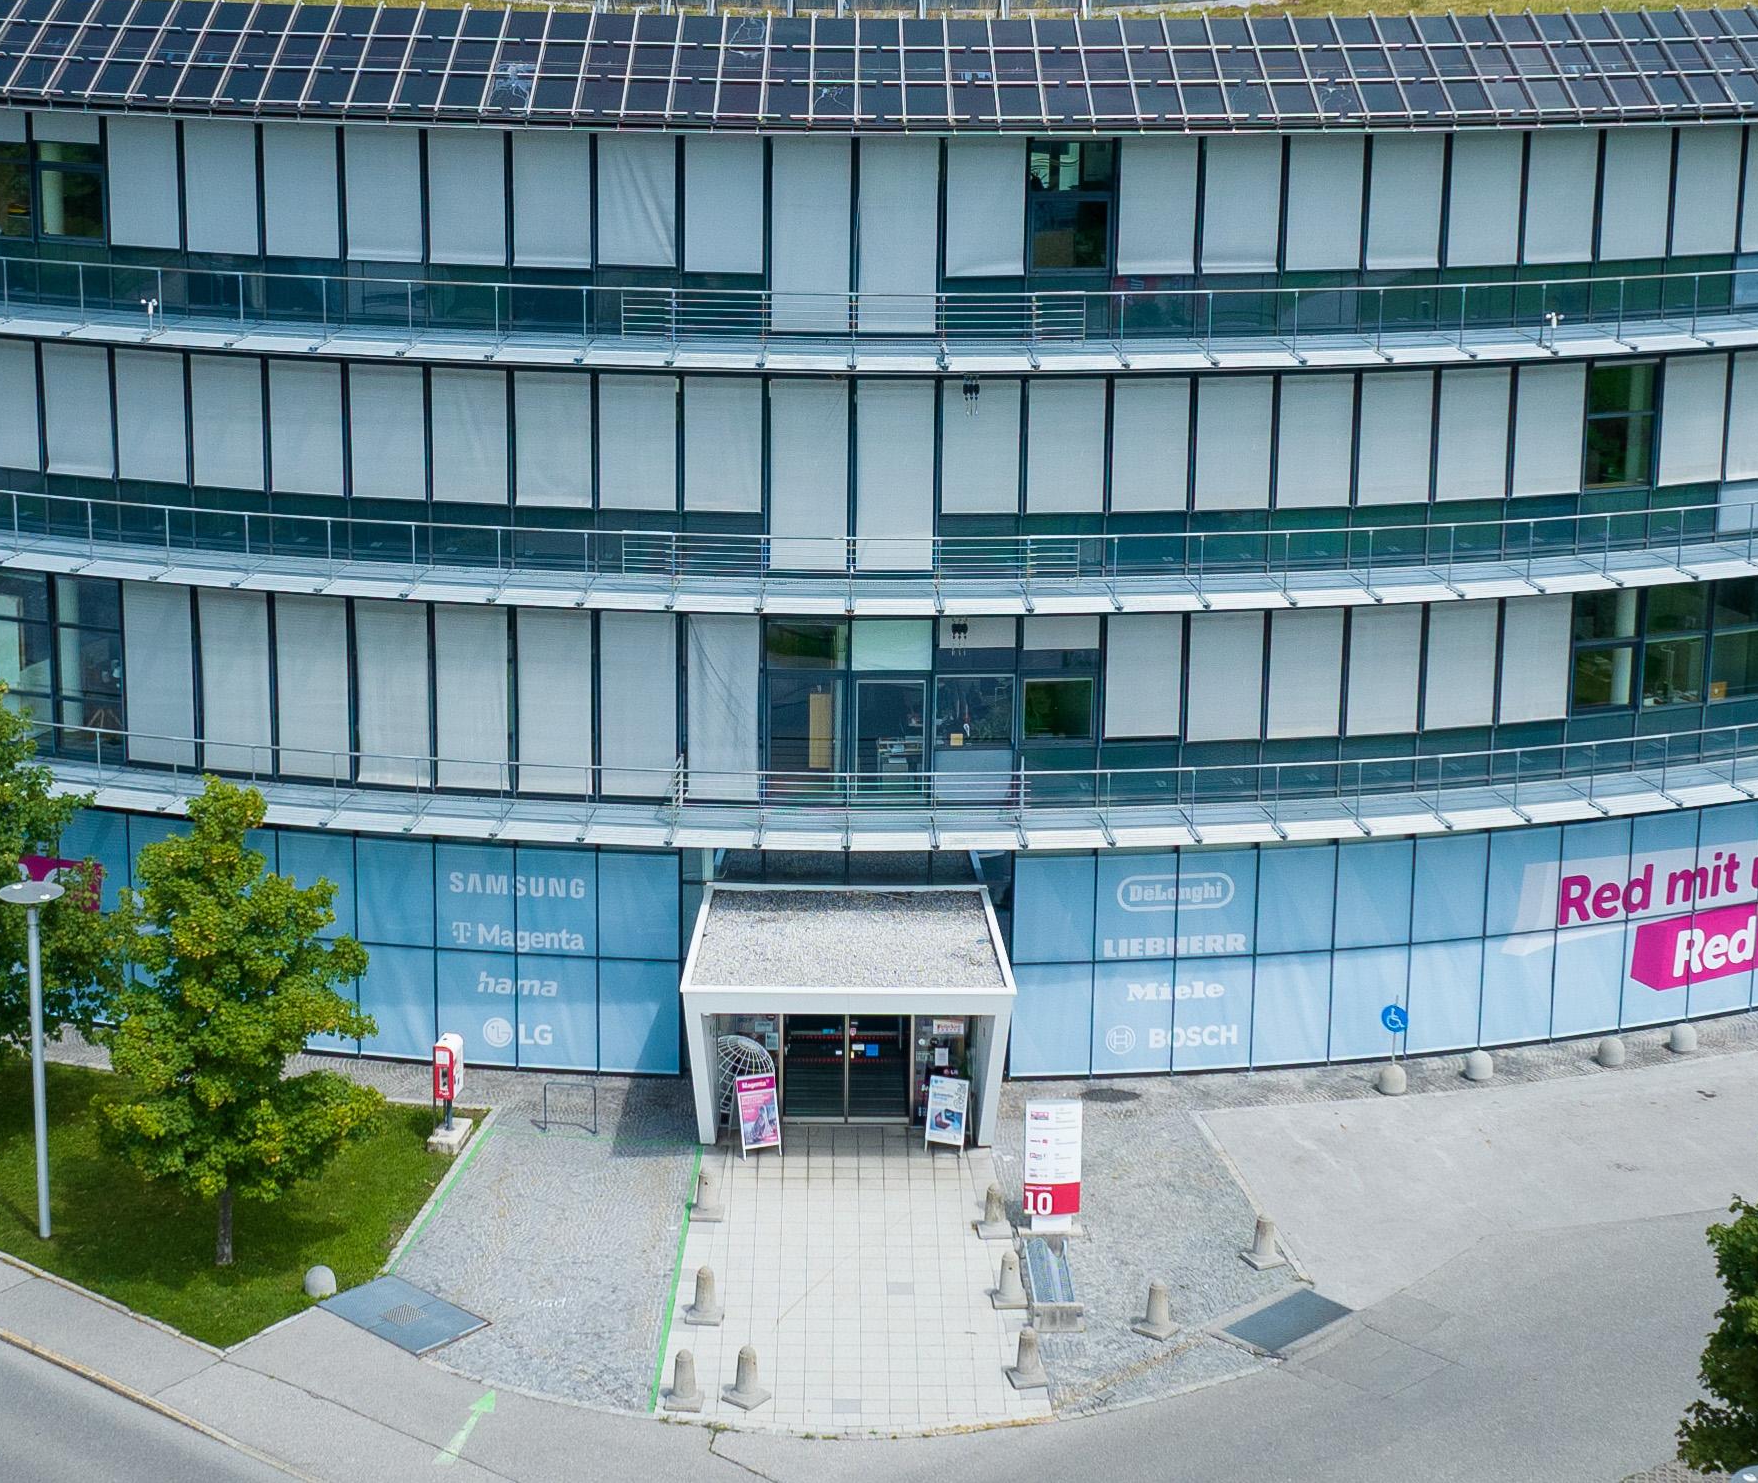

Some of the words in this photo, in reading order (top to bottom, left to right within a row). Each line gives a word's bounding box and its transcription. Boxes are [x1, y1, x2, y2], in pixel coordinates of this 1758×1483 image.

[449, 871, 585, 899] SAMSUNG
[1558, 863, 1654, 925] Red
[1666, 852, 1740, 905] mit
[477, 923, 585, 952] Magenta
[1103, 933, 1247, 957] LIEBHERR
[1673, 915, 1757, 978] Red
[477, 971, 558, 997] hama
[1126, 980, 1225, 1002] Miele
[518, 1023, 553, 1046] LG
[1148, 1024, 1238, 1049] BOSCH
[1024, 1191, 1053, 1215] 10
